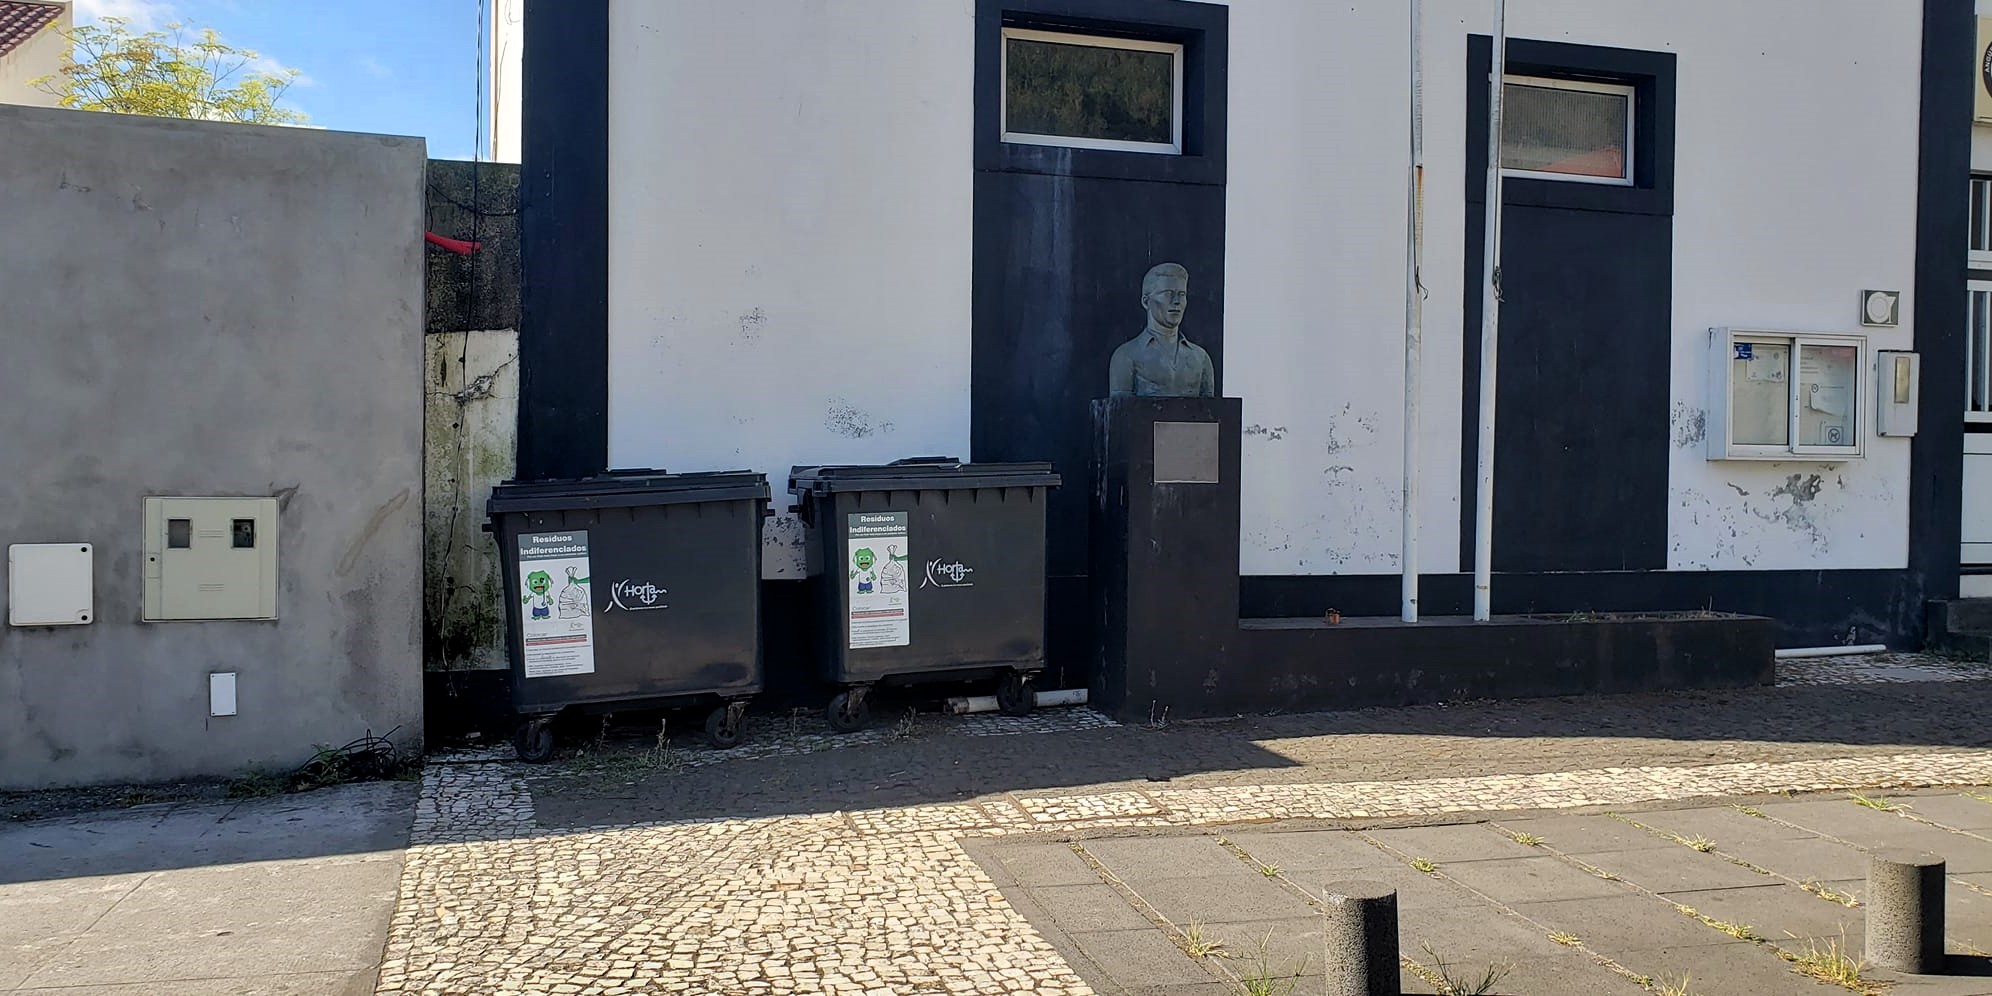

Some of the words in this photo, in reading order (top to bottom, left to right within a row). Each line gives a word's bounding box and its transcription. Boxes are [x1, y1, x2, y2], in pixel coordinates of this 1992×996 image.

[849, 525, 906, 534] Indiferenciados
[520, 544, 587, 555] Indiferenciados
[937, 561, 968, 582] Horta
[624, 581, 661, 604] Horta
